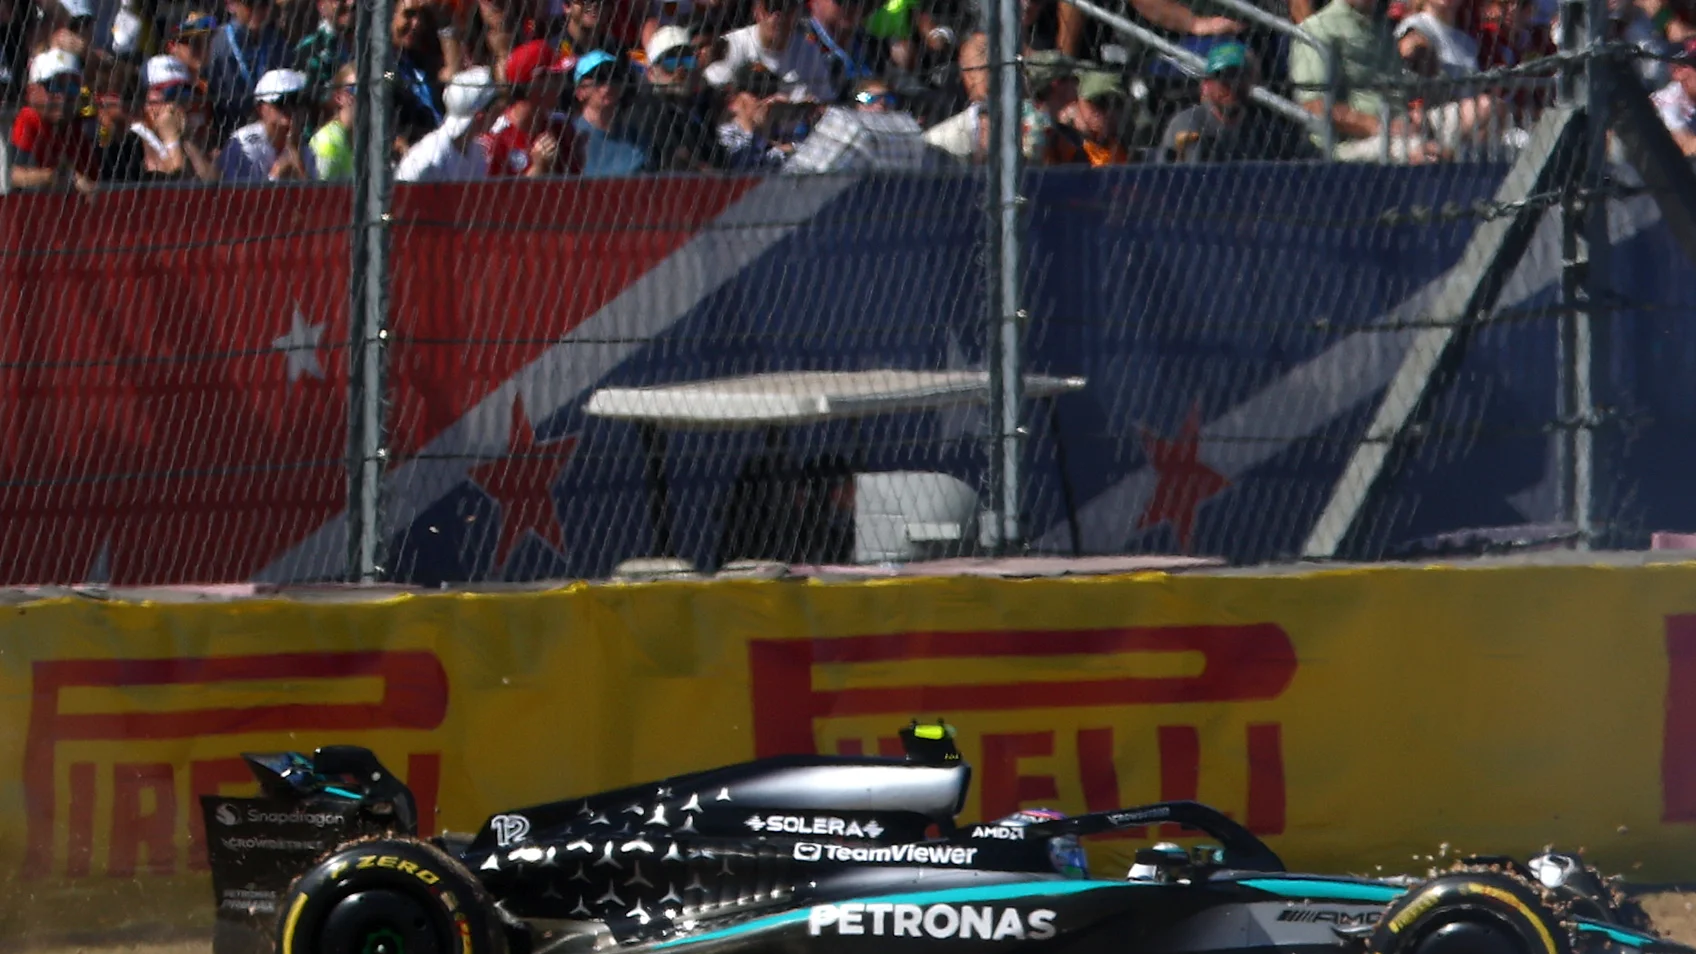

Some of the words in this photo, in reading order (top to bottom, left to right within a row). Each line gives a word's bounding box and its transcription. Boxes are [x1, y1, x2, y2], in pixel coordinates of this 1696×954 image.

[749, 622, 1297, 837] PELLI
[247, 803, 345, 828] Snapdragon
[766, 815, 865, 838] SOLERA
[490, 814, 530, 847] 12
[971, 826, 1010, 839] AMD
[825, 844, 978, 865] TeamViewer
[331, 861, 349, 880] P
[358, 855, 440, 885] ZERO
[808, 903, 1057, 941] PETRONAS
